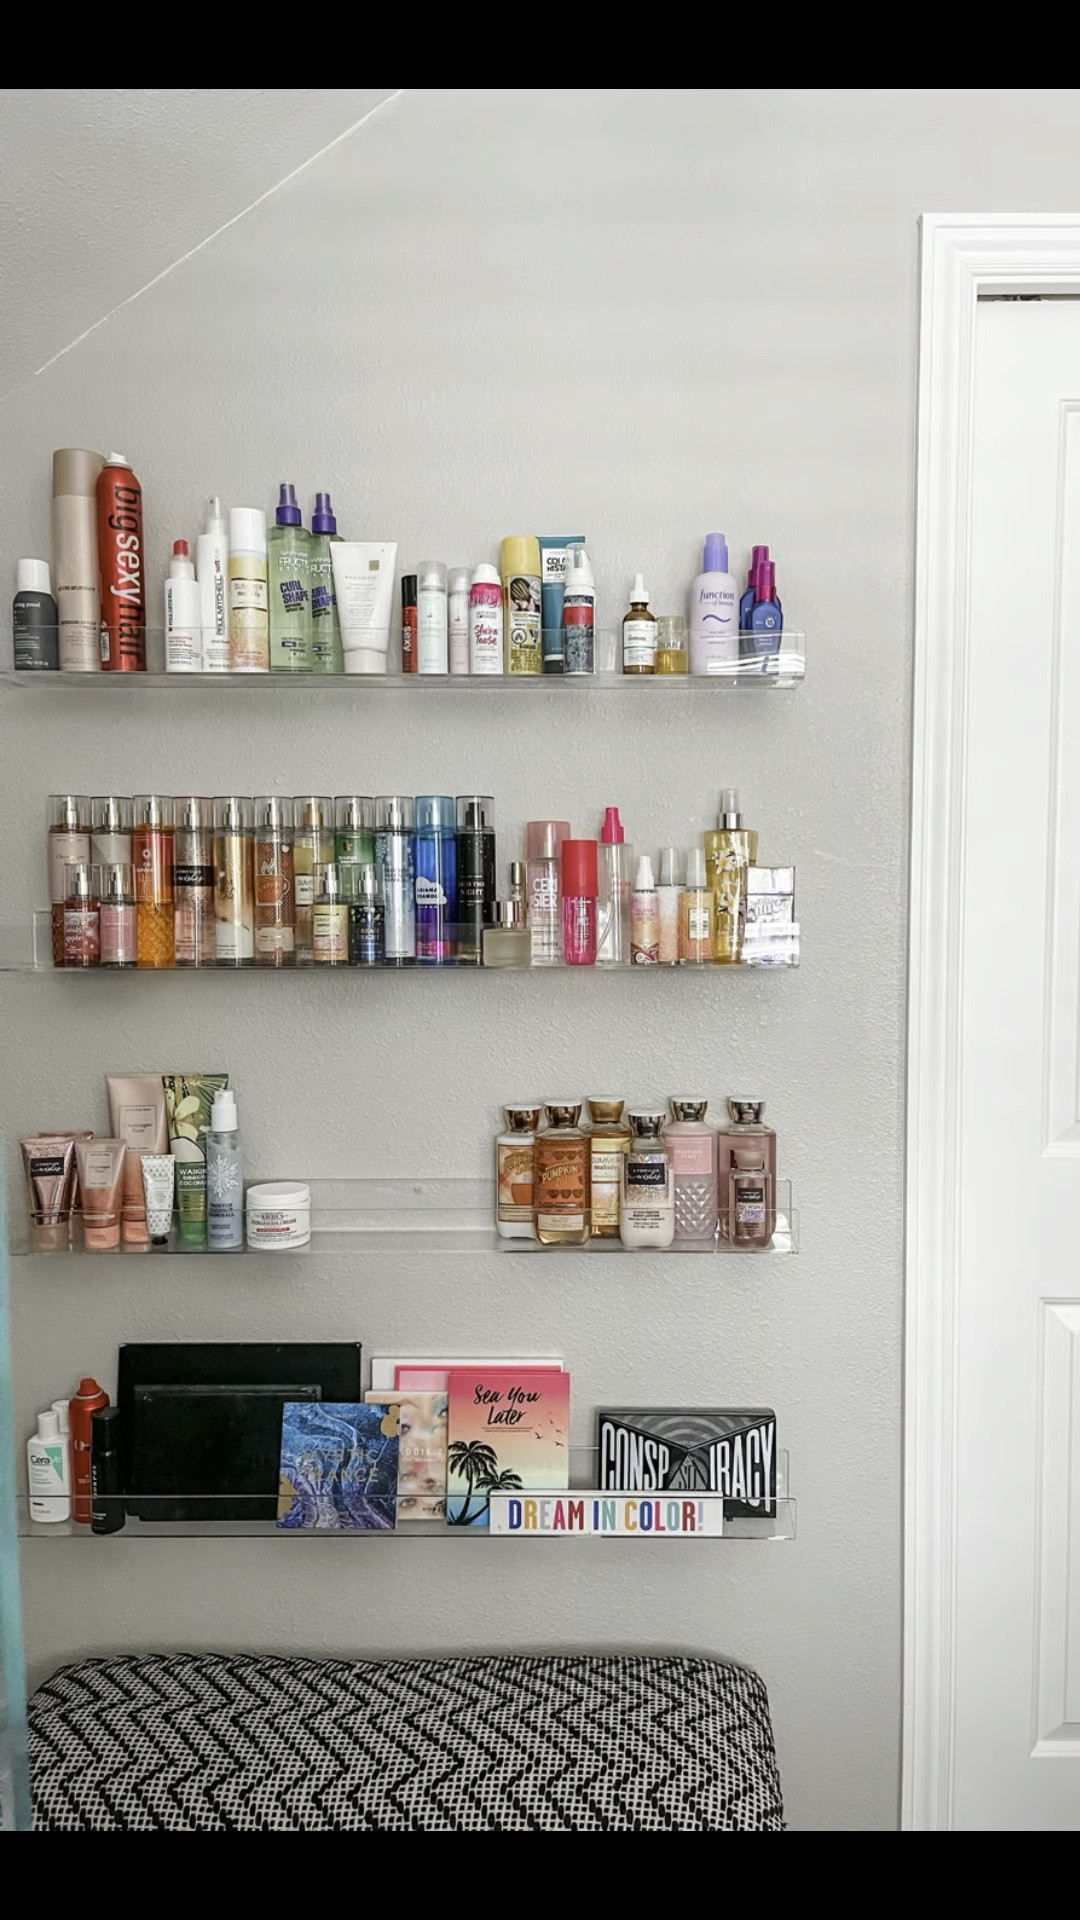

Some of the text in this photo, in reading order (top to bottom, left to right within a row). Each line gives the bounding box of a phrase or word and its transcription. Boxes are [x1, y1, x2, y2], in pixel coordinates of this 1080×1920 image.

[109, 484, 142, 662] bigsexyhair
[279, 580, 303, 593] CURL
[282, 591, 308, 604] SHAPE
[699, 588, 735, 602] function
[215, 575, 225, 635] PAUL MITCHELL
[403, 625, 412, 651] sexy
[475, 635, 498, 645] Tease
[542, 1163, 578, 1185] PUMPKIN
[474, 1384, 542, 1410] Sea You
[487, 1405, 527, 1426] Later
[508, 1499, 704, 1532] DREAM IN COLOR!
